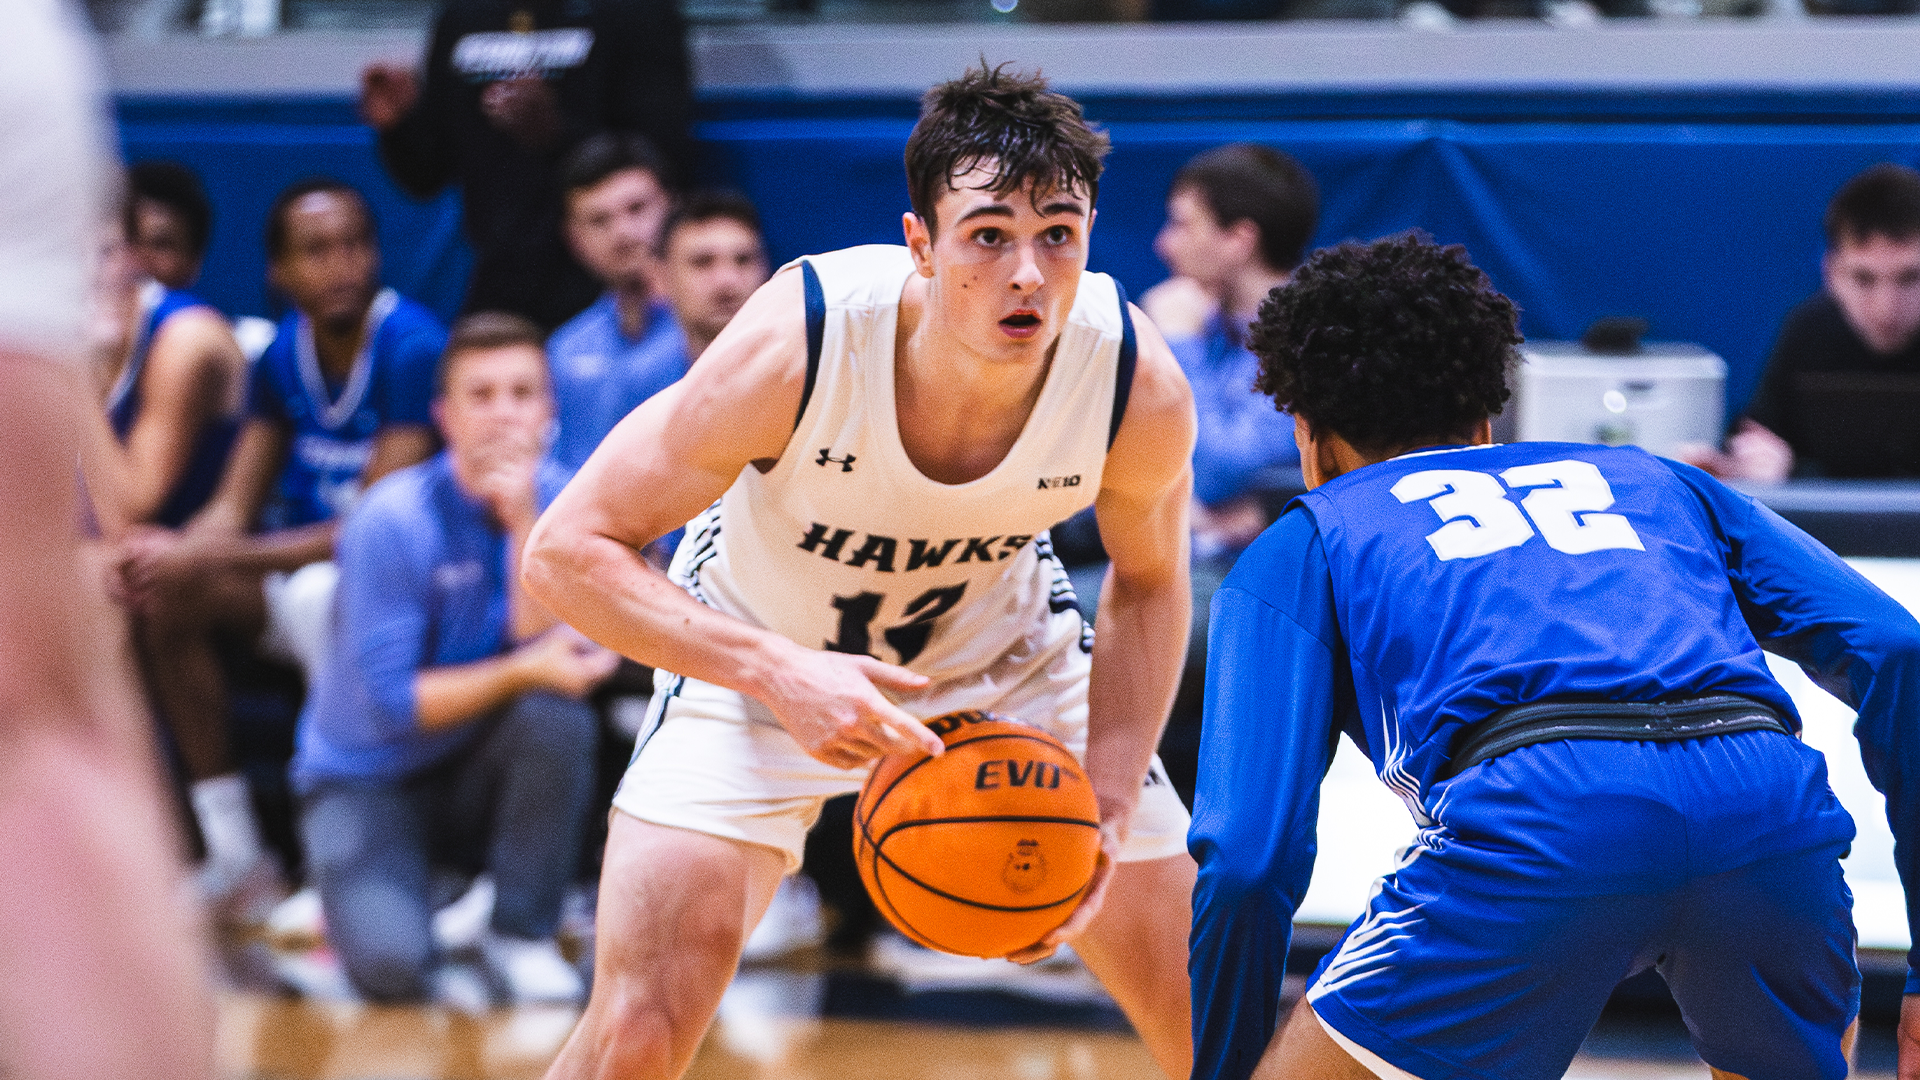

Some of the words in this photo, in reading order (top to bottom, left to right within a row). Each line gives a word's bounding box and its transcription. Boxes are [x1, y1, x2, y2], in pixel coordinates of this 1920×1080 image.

[1389, 459, 1646, 561] 32
[797, 522, 1033, 573] HAWKS
[974, 758, 1061, 790] EVO
